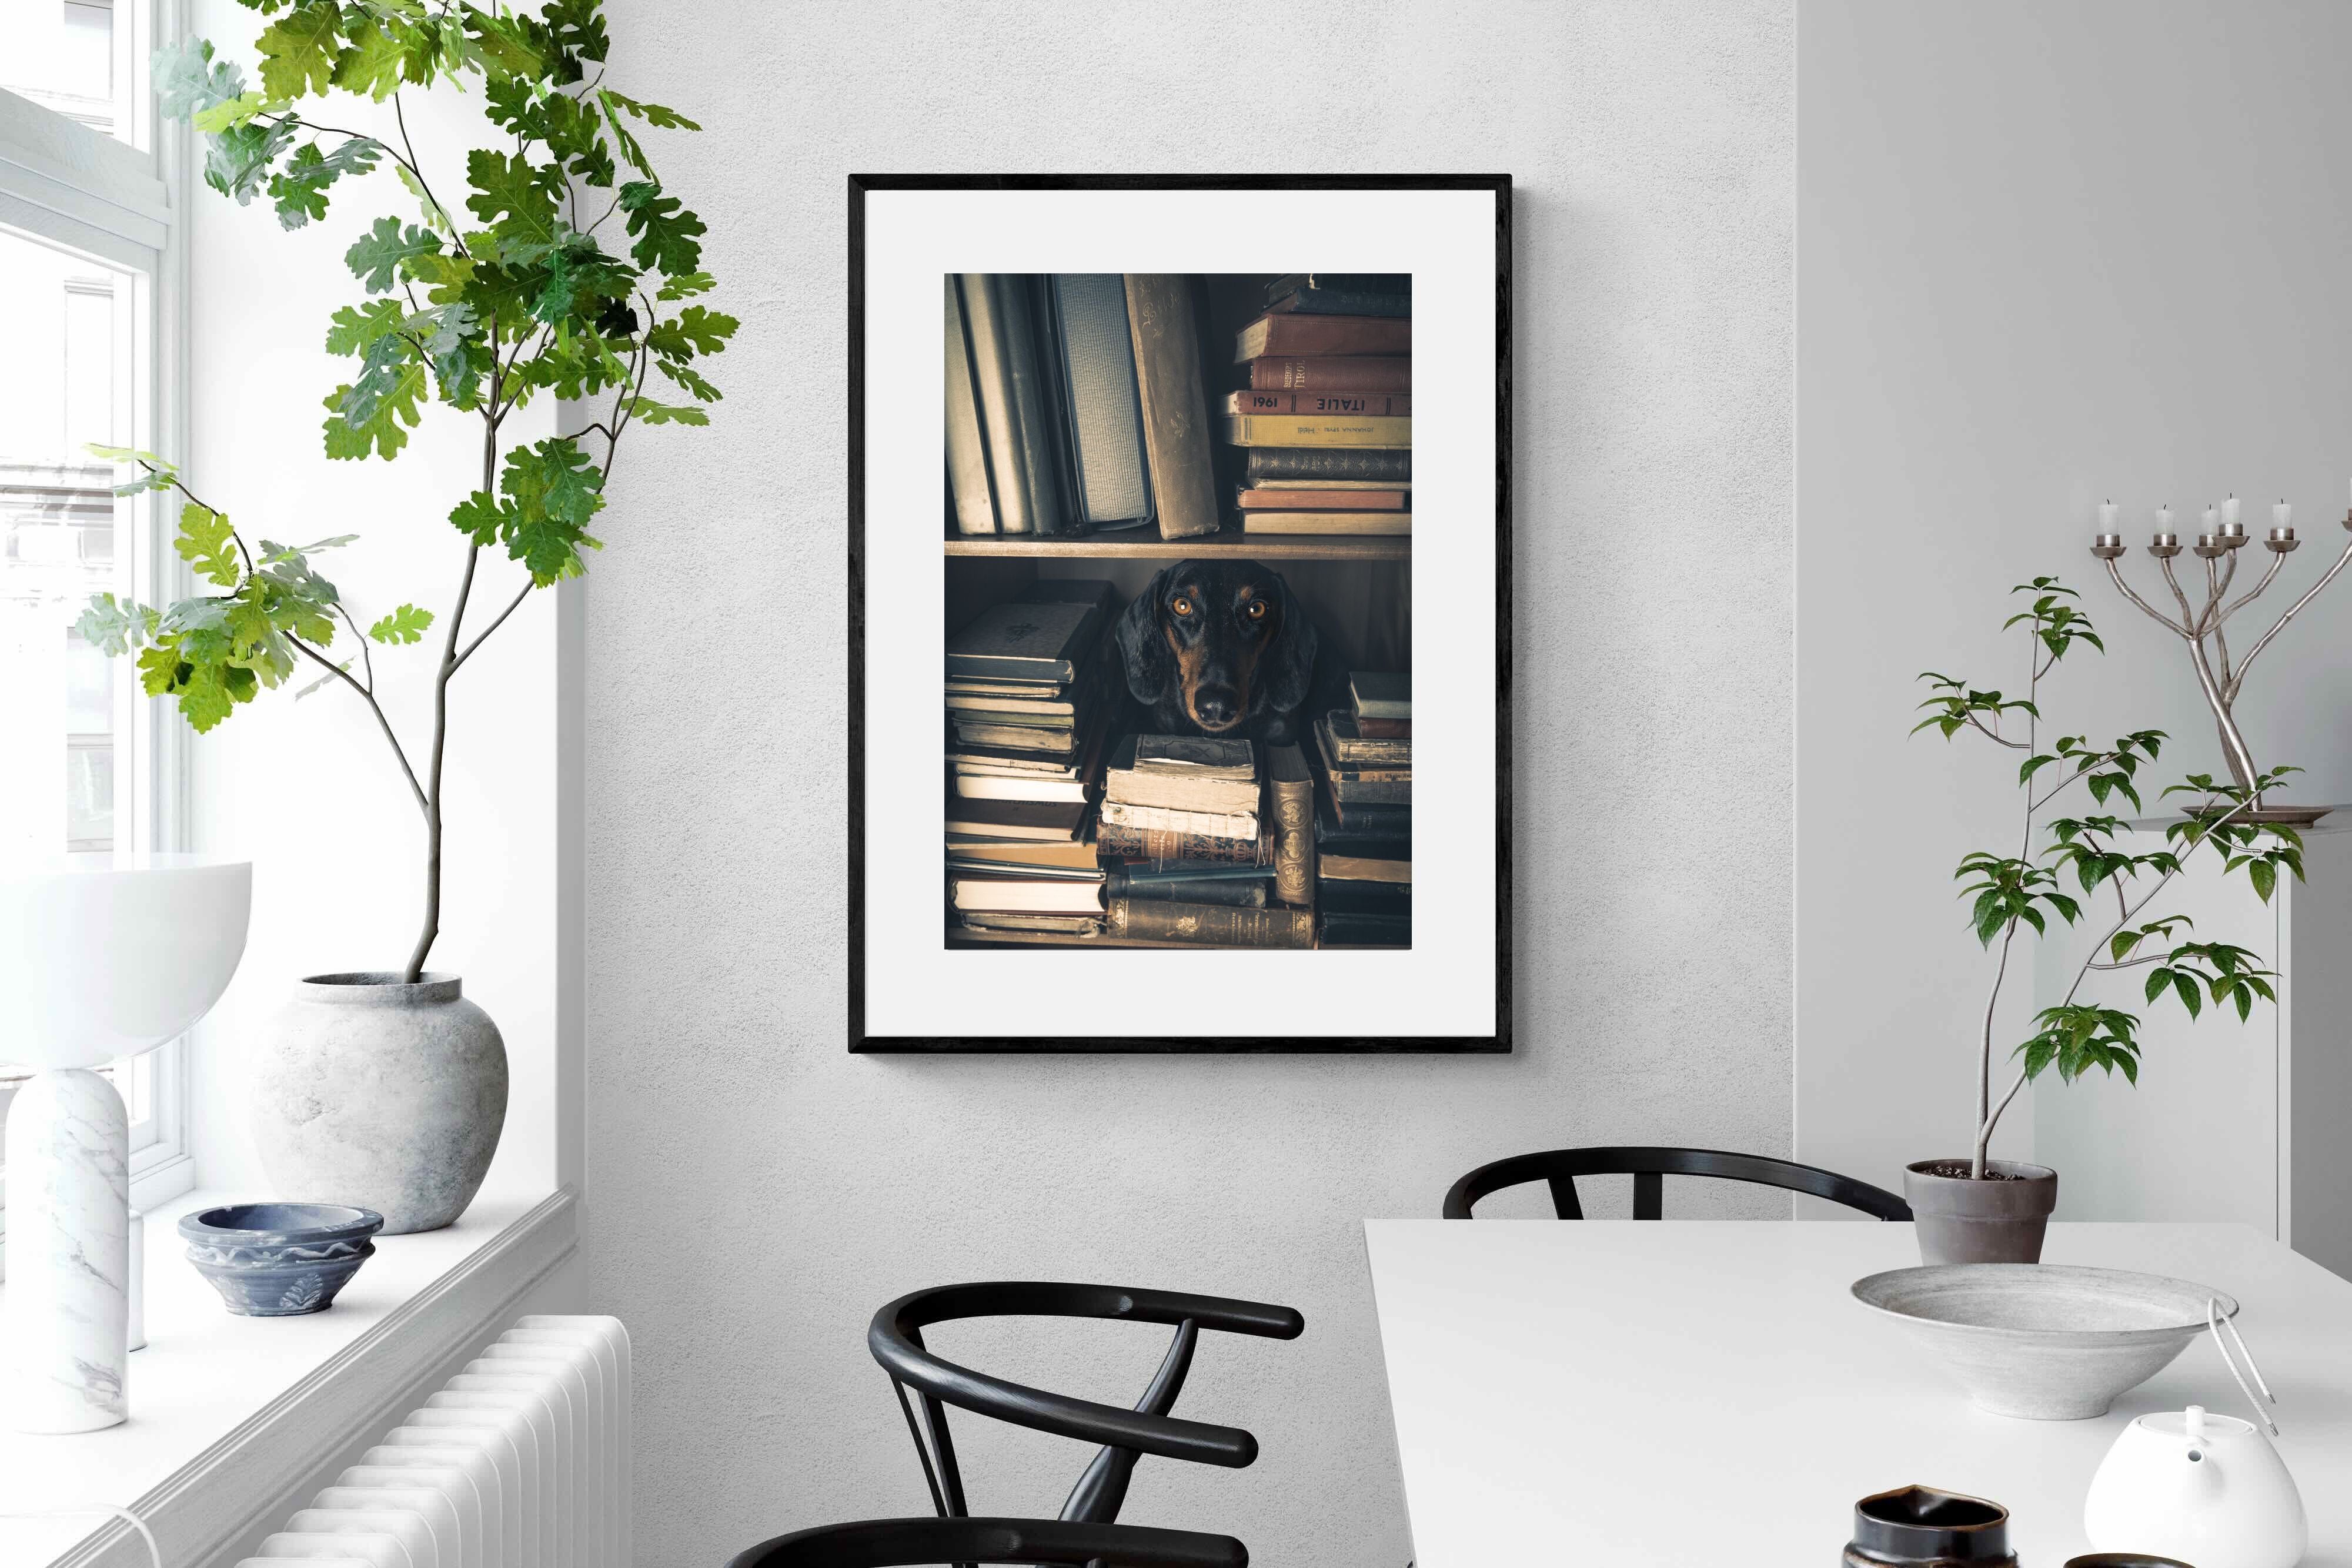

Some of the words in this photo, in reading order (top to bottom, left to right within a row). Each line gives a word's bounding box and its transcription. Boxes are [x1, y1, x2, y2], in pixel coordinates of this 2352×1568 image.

[1294, 360, 1307, 390] TIROL
[1253, 397, 1278, 407] 1961
[1317, 398, 1365, 411] ITALIE
